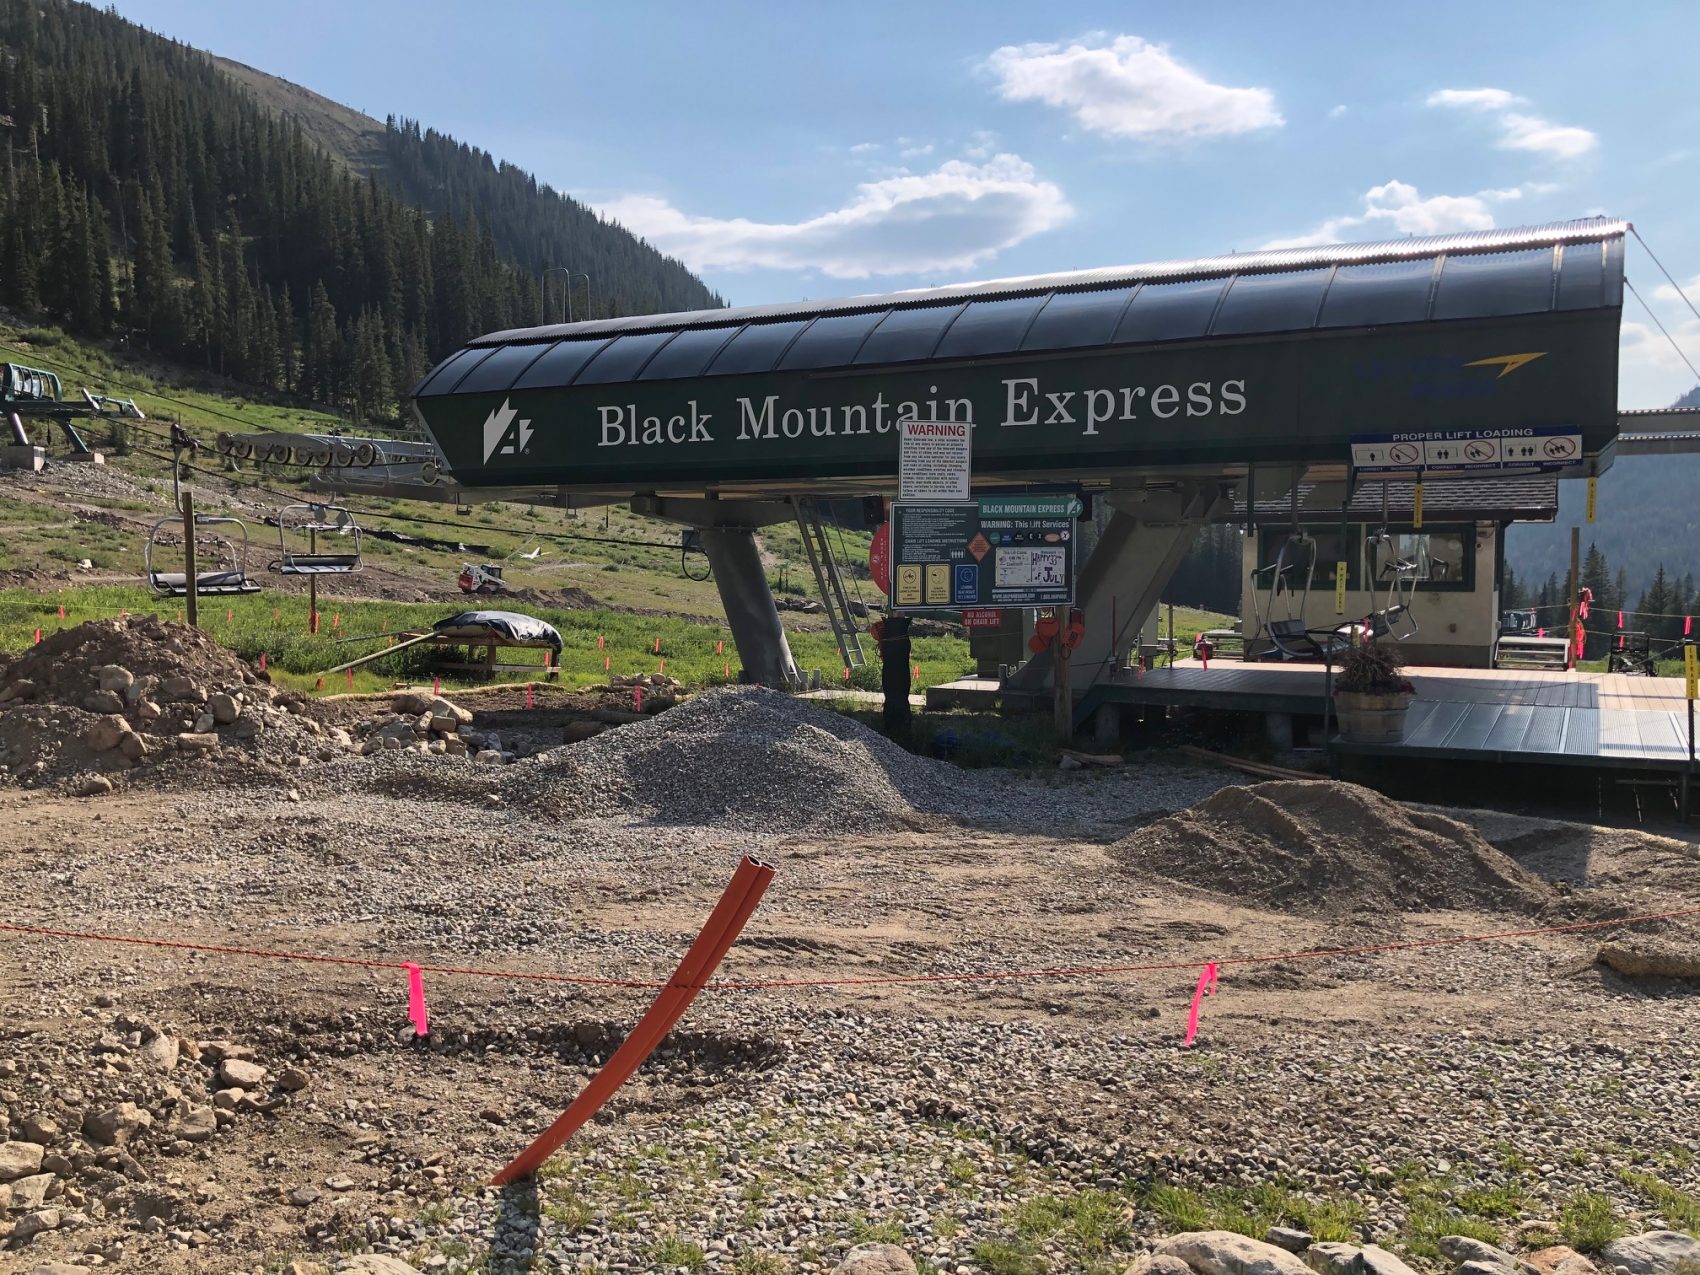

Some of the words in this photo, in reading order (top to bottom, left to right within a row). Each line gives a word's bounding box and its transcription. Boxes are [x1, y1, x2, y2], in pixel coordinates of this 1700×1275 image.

[597, 401, 714, 446] Black
[736, 385, 976, 440] Mountain
[1000, 378, 1247, 436] Express
[907, 424, 966, 437] WARNING
[1392, 432, 1443, 441] PROPER
[1446, 431, 1472, 440] LIFT
[1476, 428, 1534, 438] LOADING
[982, 504, 1004, 514] BLACK
[1004, 504, 1037, 514] MOUNTAIN
[1038, 504, 1065, 513] EXPRESS
[980, 520, 1013, 529] WARNING:
[1015, 520, 1028, 528] This
[1029, 520, 1041, 528] Lift
[1042, 520, 1070, 528] Services
[1043, 566, 1064, 584] JULY
